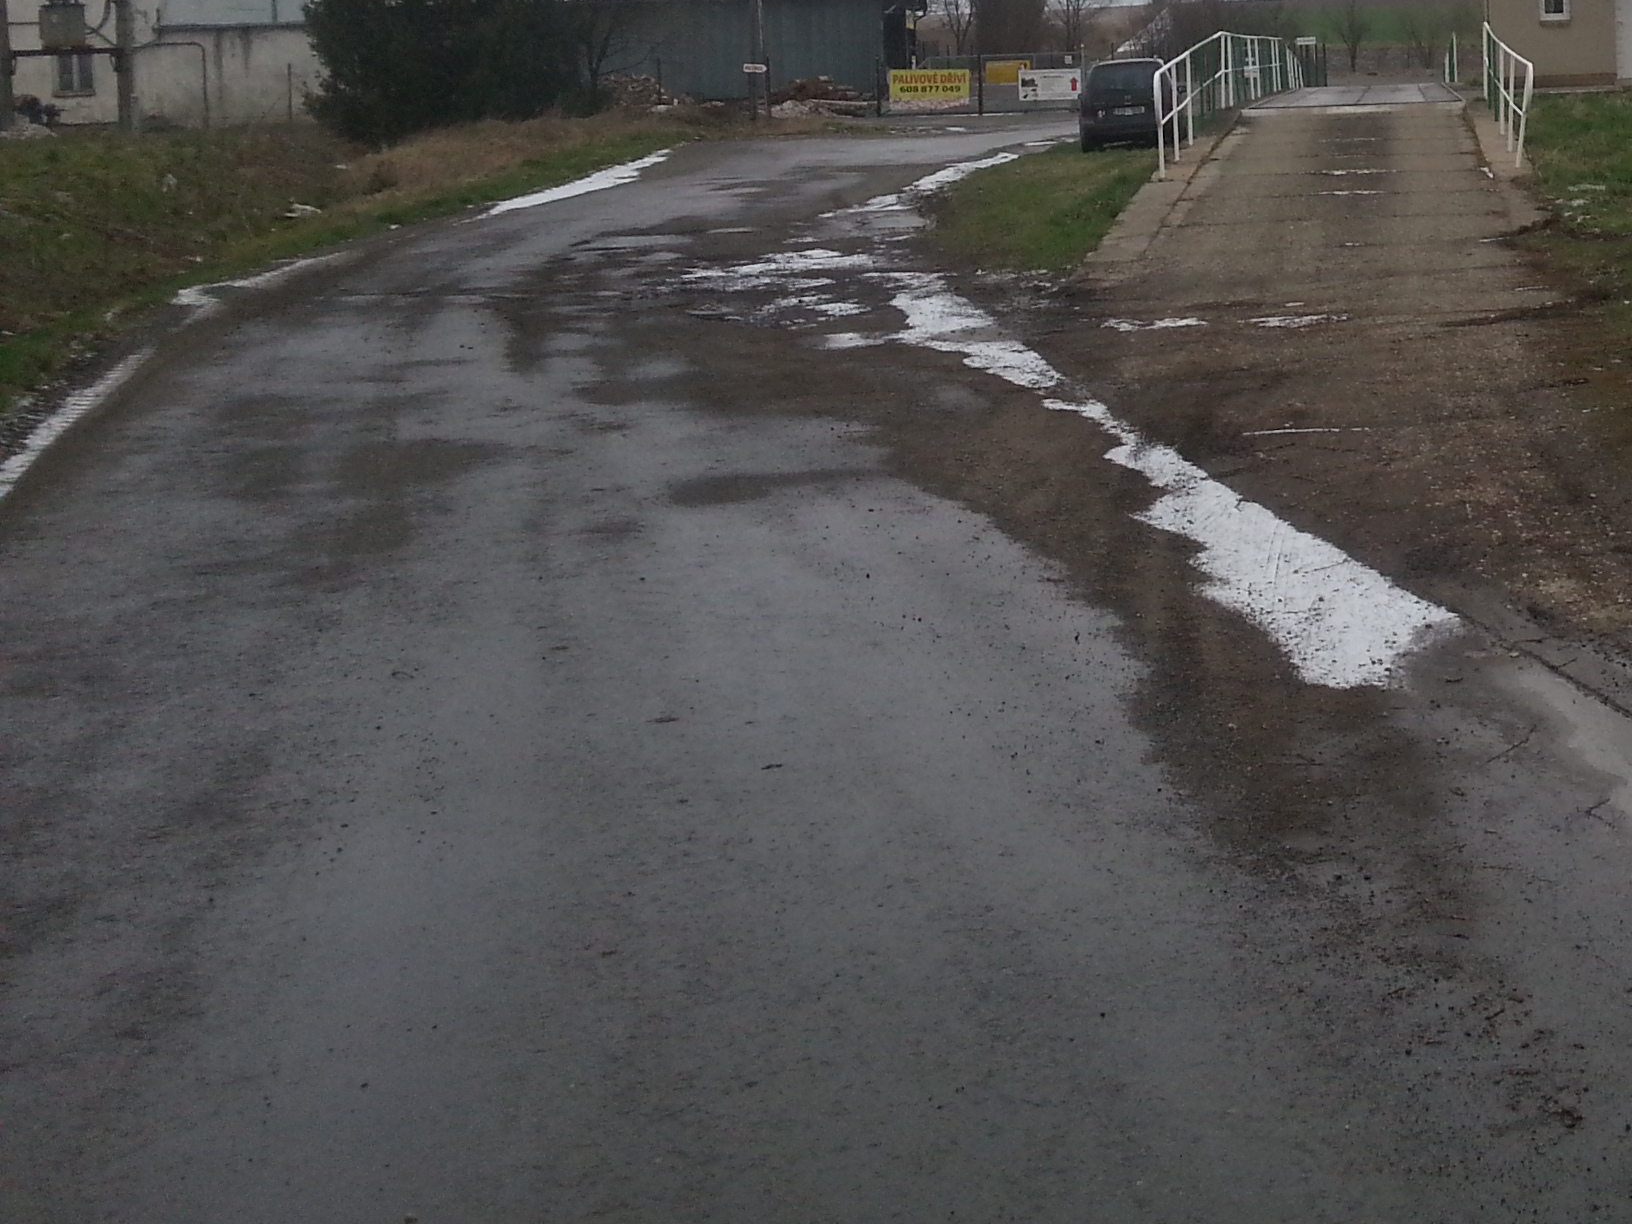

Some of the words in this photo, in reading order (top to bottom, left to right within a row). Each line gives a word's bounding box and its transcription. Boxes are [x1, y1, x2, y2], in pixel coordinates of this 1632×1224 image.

[892, 71, 938, 84] PALIVOVÉ
[900, 85, 919, 93] 608
[921, 85, 940, 93] 877
[942, 85, 961, 93] 049
